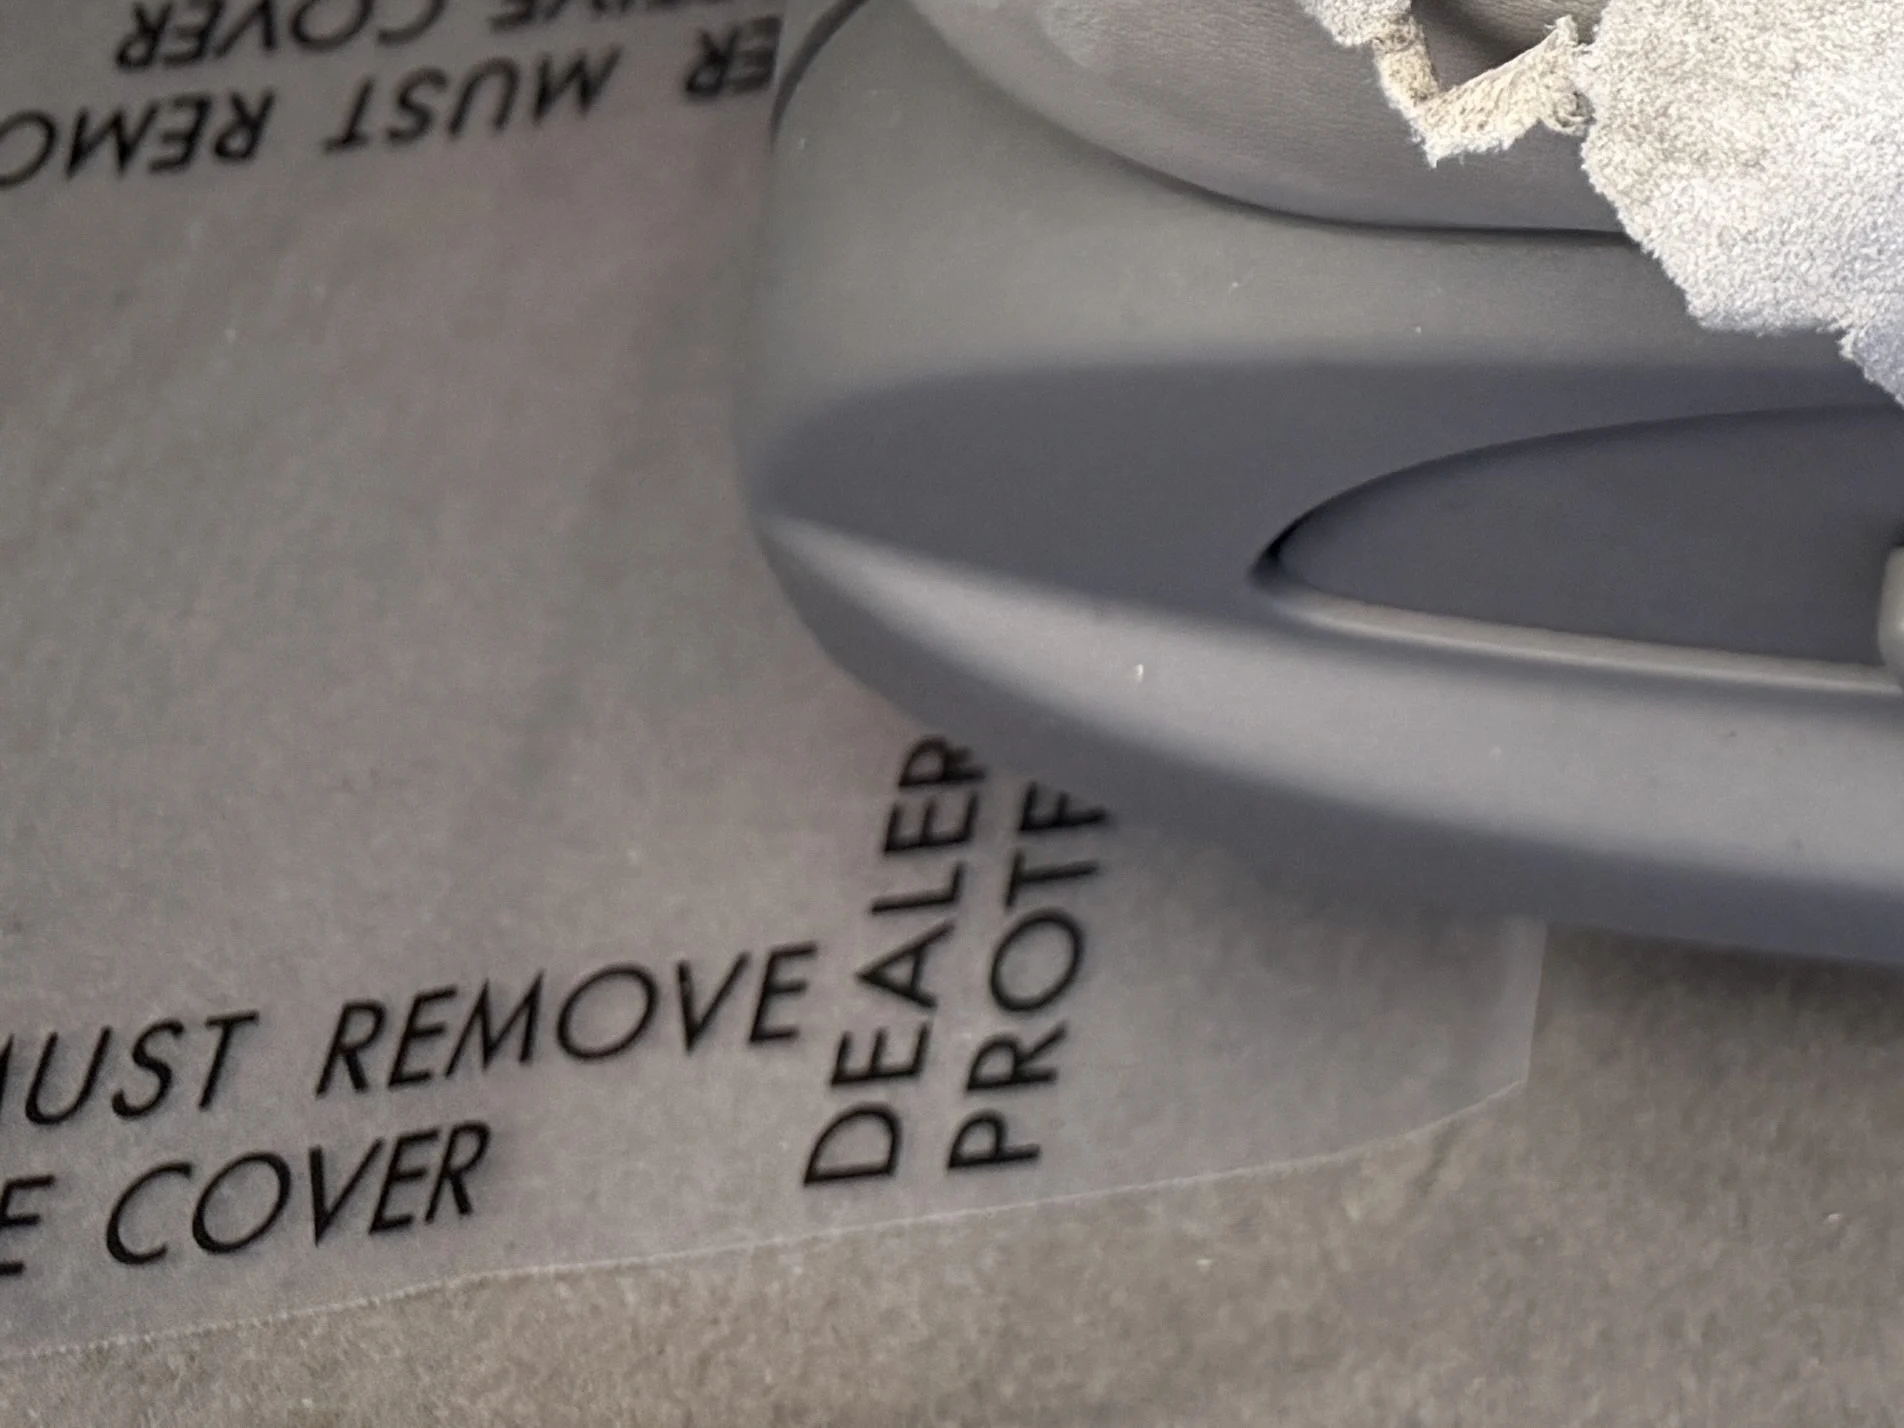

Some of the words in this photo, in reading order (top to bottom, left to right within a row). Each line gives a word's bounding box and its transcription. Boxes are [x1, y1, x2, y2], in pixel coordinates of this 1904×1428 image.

[323, 46, 624, 154] MUST
[314, 942, 818, 1097] REMOVE
[803, 733, 988, 1188] DEALER
[105, 1120, 491, 1267] COVER
